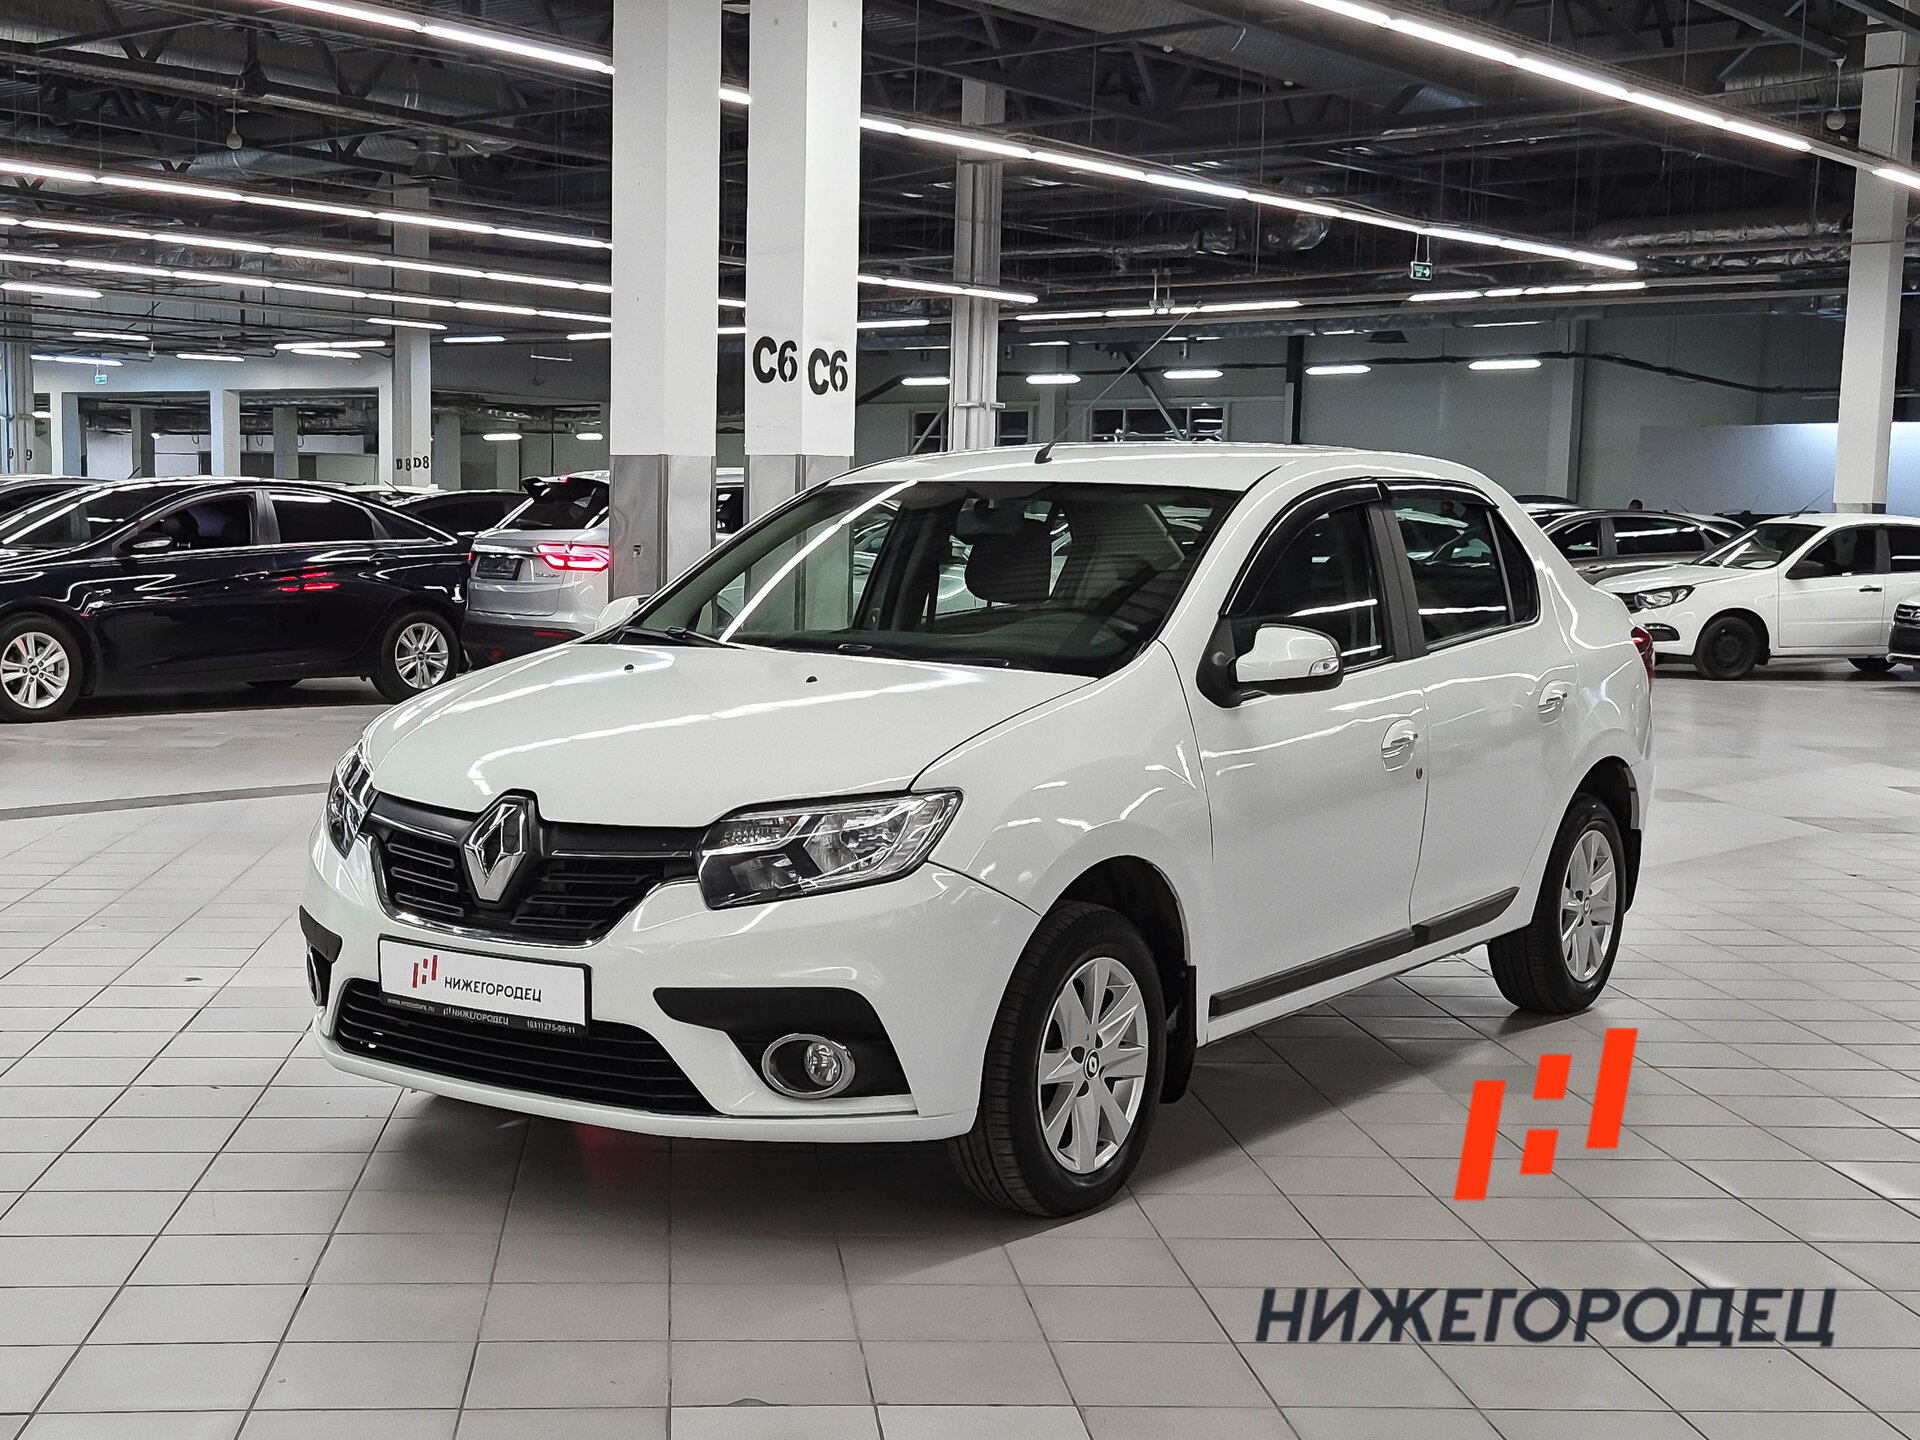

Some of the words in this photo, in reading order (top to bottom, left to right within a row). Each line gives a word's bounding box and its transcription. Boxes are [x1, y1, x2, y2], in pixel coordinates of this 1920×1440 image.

[752, 336, 798, 383] C6
[808, 348, 848, 395] C6
[413, 456, 429, 469] D8
[444, 976, 542, 1002] НИЖЕГОРОДЕЦ
[452, 1008, 509, 1025] НИЖЕГОРОДЕЦ
